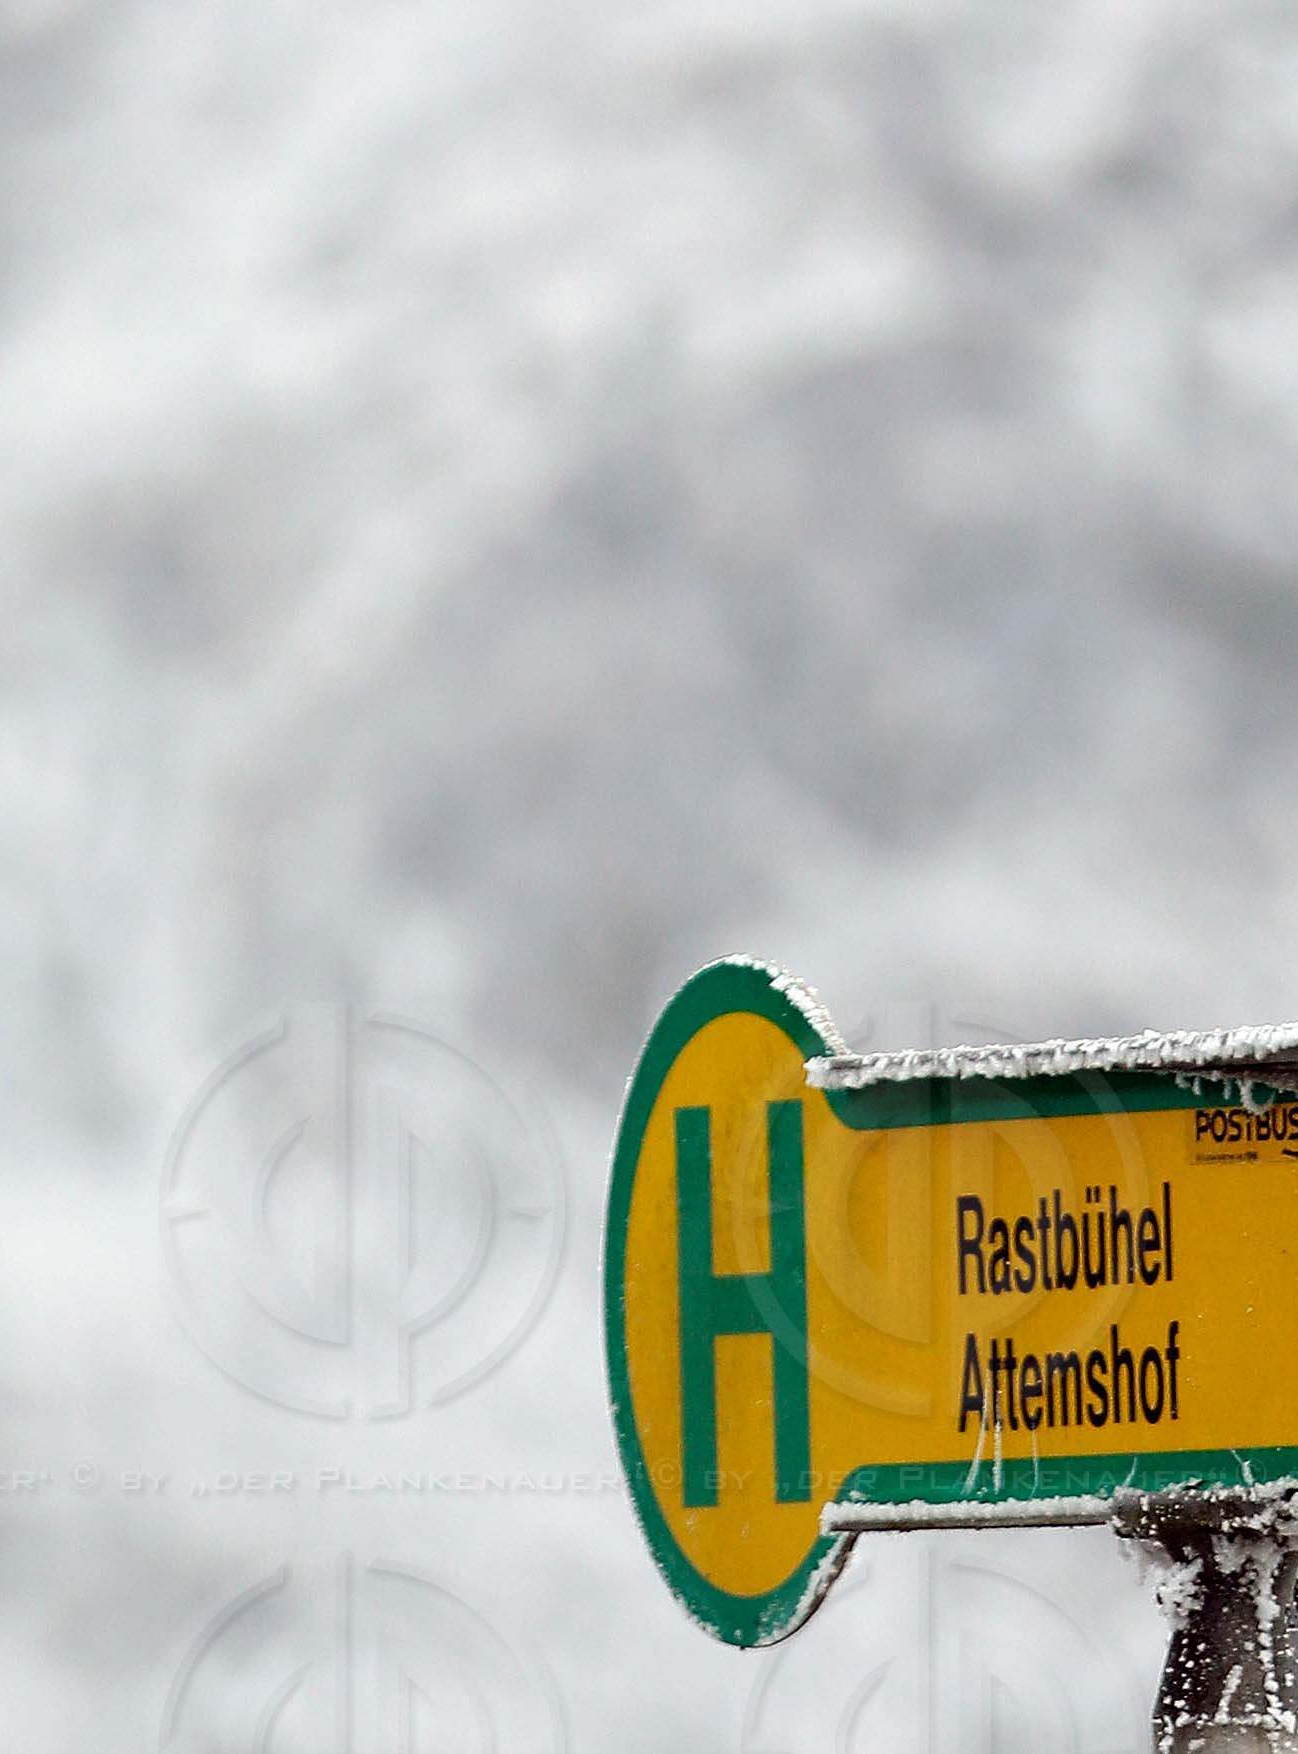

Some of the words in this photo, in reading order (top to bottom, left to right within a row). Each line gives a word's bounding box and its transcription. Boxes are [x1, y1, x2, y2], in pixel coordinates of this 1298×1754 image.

[957, 1182, 1175, 1295] Rastbühel
[674, 1099, 811, 1507] H
[958, 1322, 1181, 1432] Attemshof
